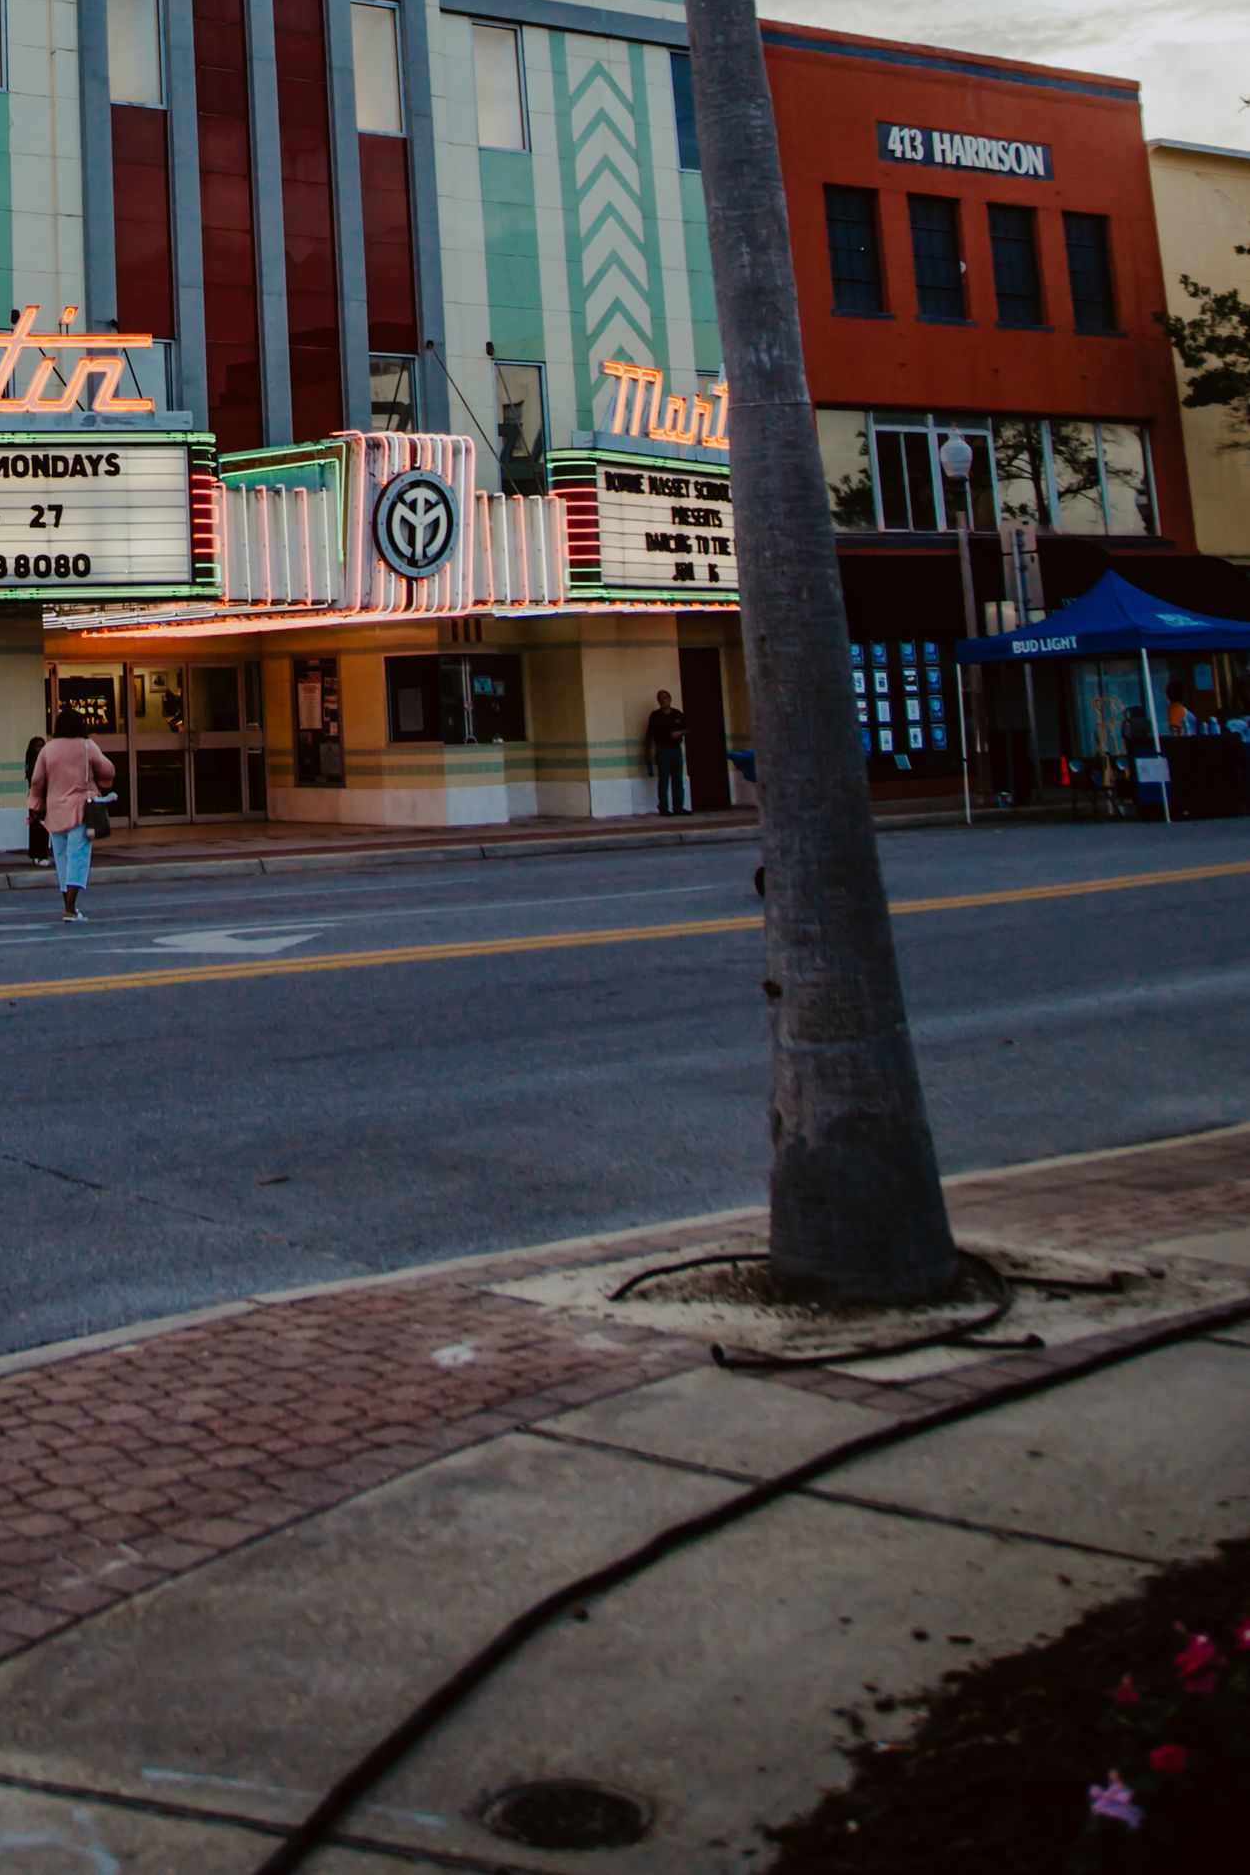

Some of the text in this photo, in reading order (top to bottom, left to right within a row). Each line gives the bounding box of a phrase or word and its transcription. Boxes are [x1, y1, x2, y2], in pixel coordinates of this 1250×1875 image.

[887, 126, 1045, 176] 413 HARRISON
[603, 359, 729, 450] Mart
[29, 504, 63, 528] 27
[671, 506, 722, 528] PRESENTS
[695, 534, 709, 555] TO
[1012, 635, 1078, 654] BUD LIGHT
